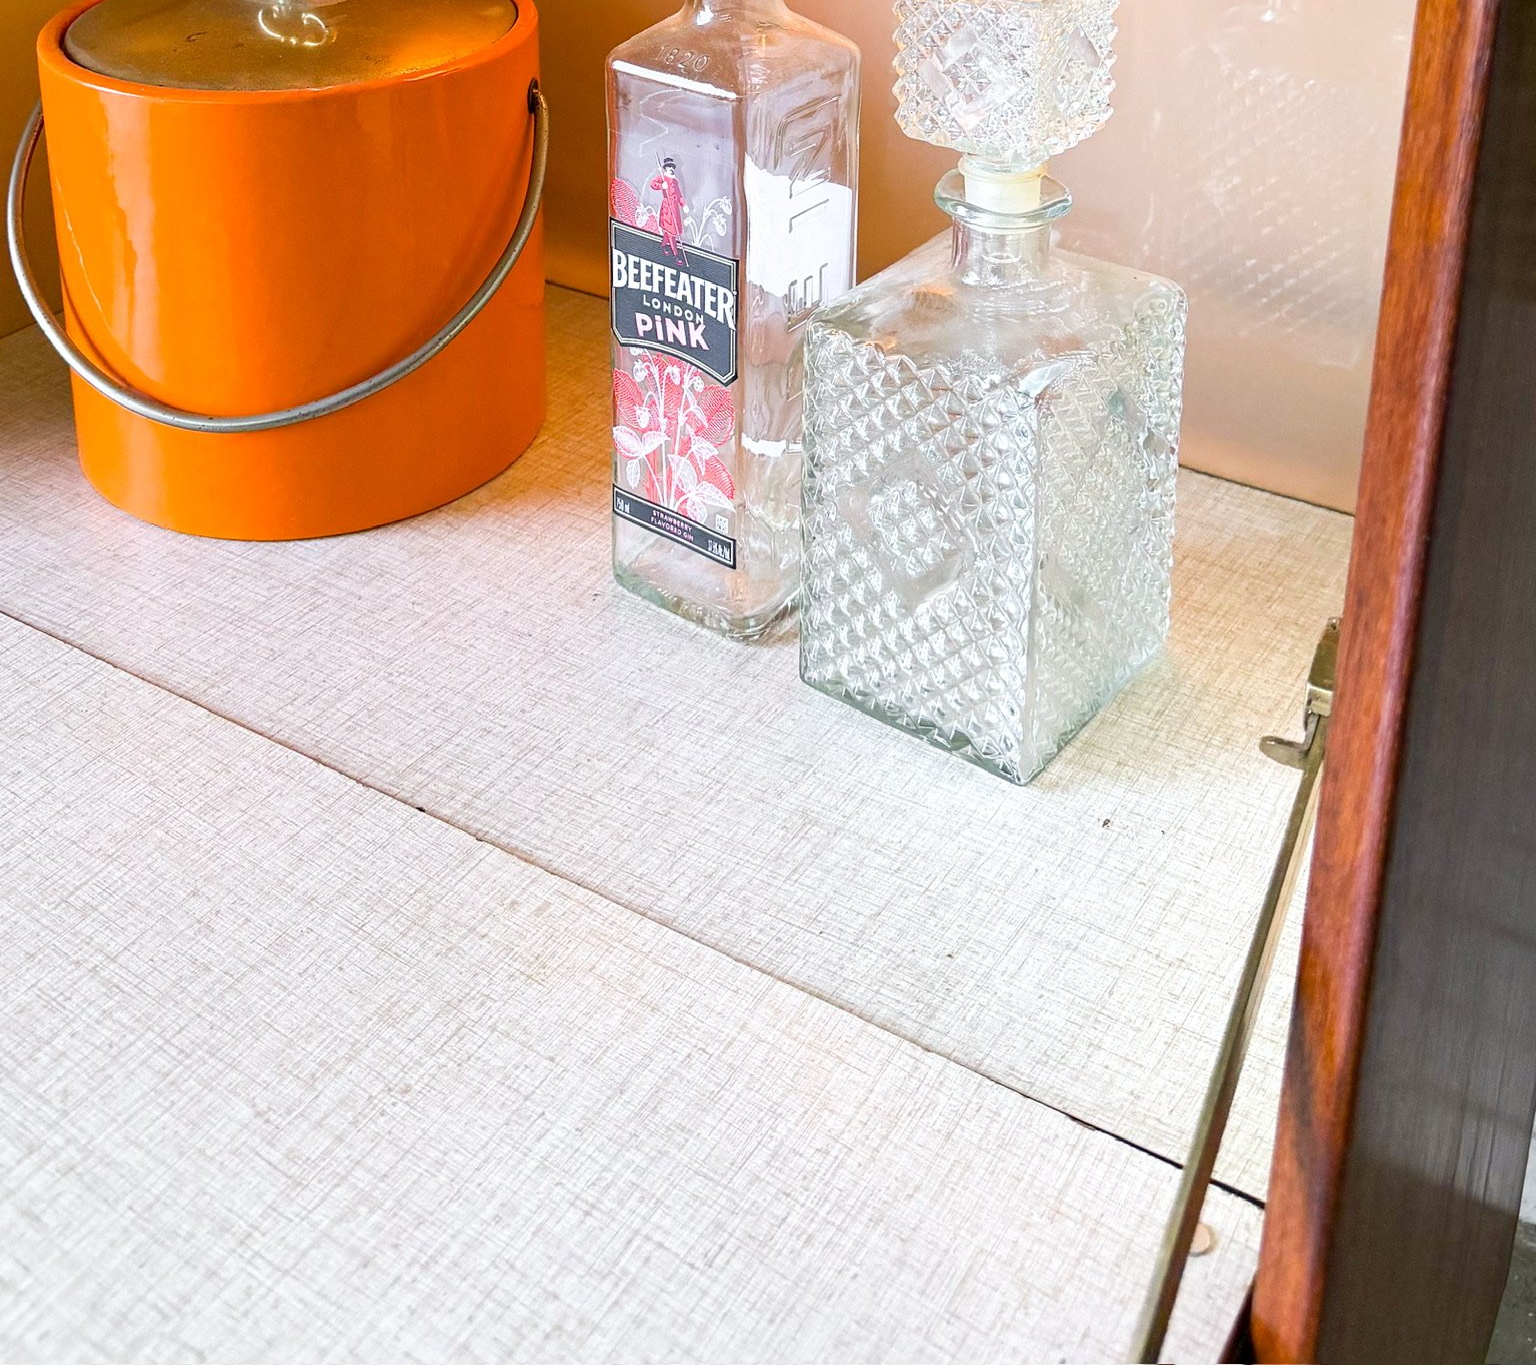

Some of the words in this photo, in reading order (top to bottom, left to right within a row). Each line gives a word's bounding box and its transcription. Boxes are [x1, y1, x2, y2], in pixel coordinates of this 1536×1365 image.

[656, 44, 710, 72] 1820
[612, 248, 737, 331] BEEFEATER
[643, 294, 705, 325] LONDON
[650, 517, 682, 535] FLAVORED
[683, 531, 694, 542] GIN
[652, 510, 692, 533] STRAWBERRY
